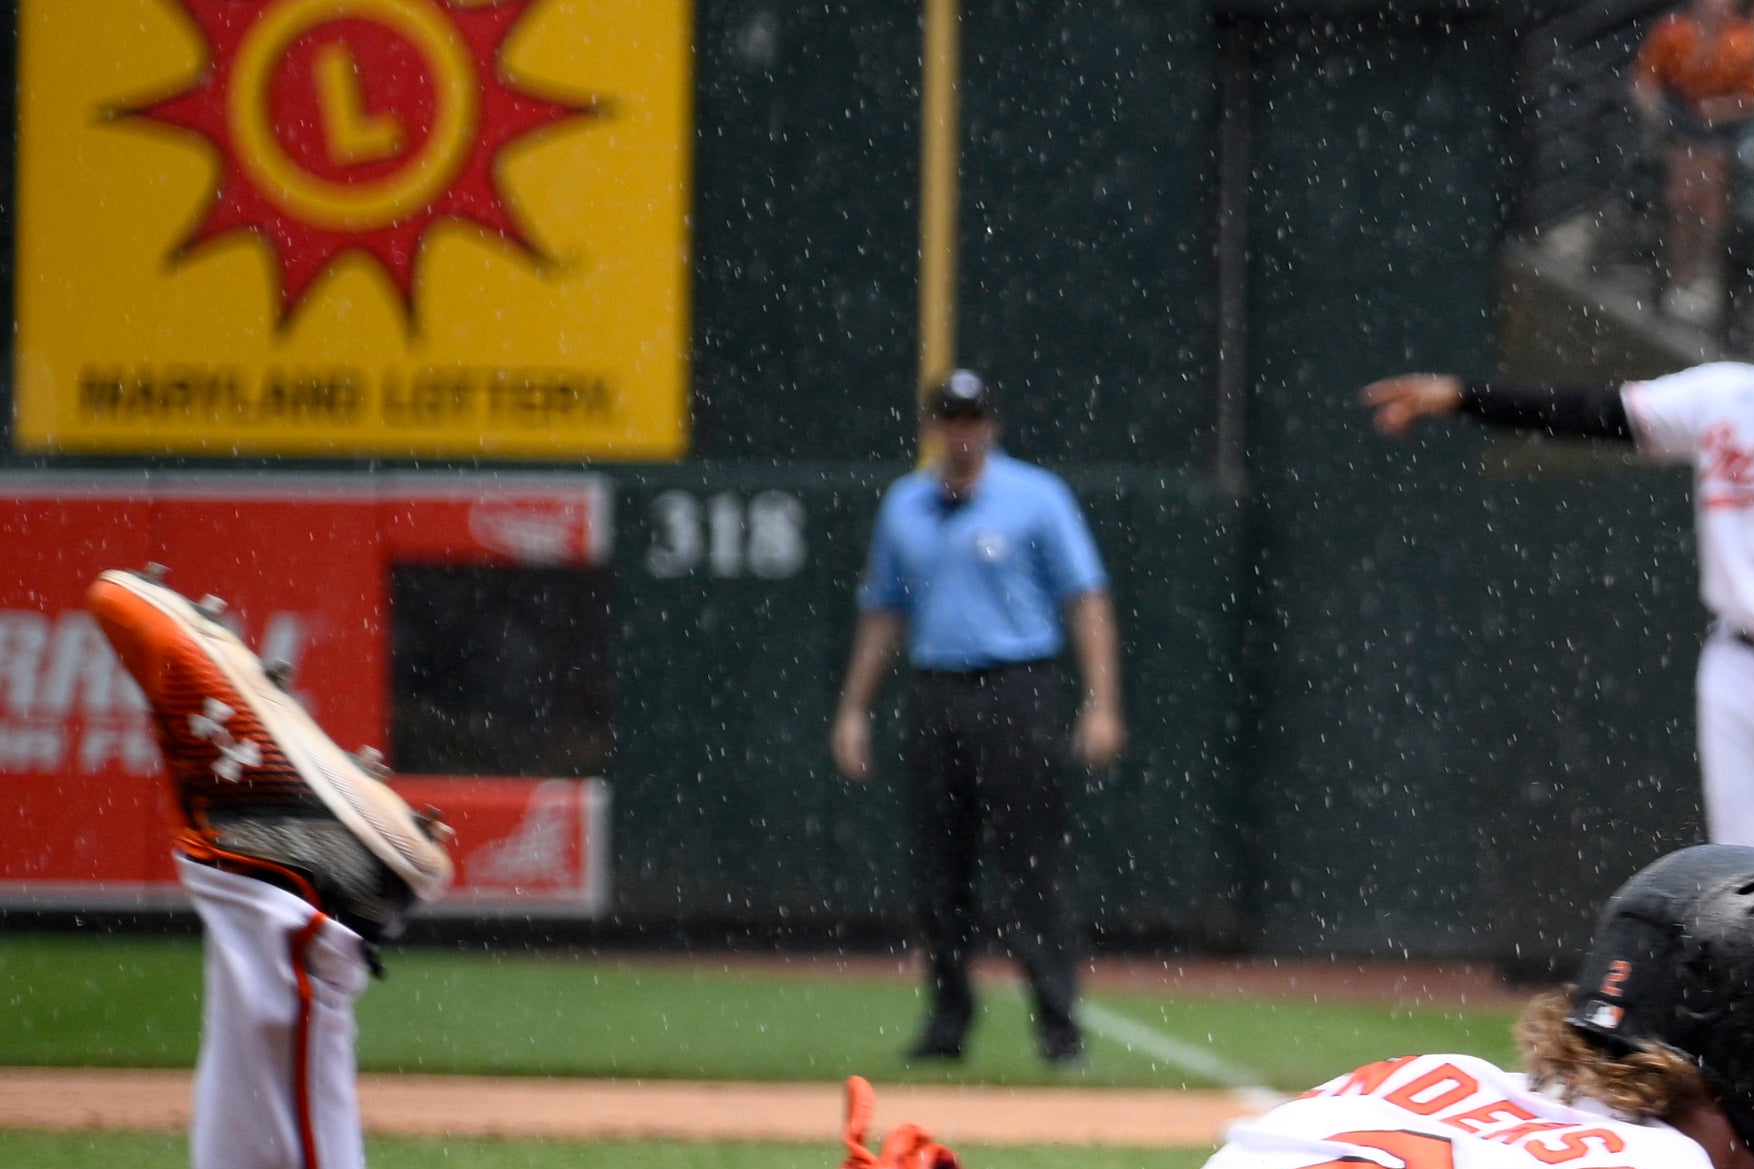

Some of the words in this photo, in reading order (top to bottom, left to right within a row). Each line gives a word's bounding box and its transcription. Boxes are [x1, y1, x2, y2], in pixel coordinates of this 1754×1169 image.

[313, 43, 402, 167] L
[380, 362, 613, 426] LOTTERY
[646, 489, 806, 579] 318
[1601, 960, 1632, 997] 2
